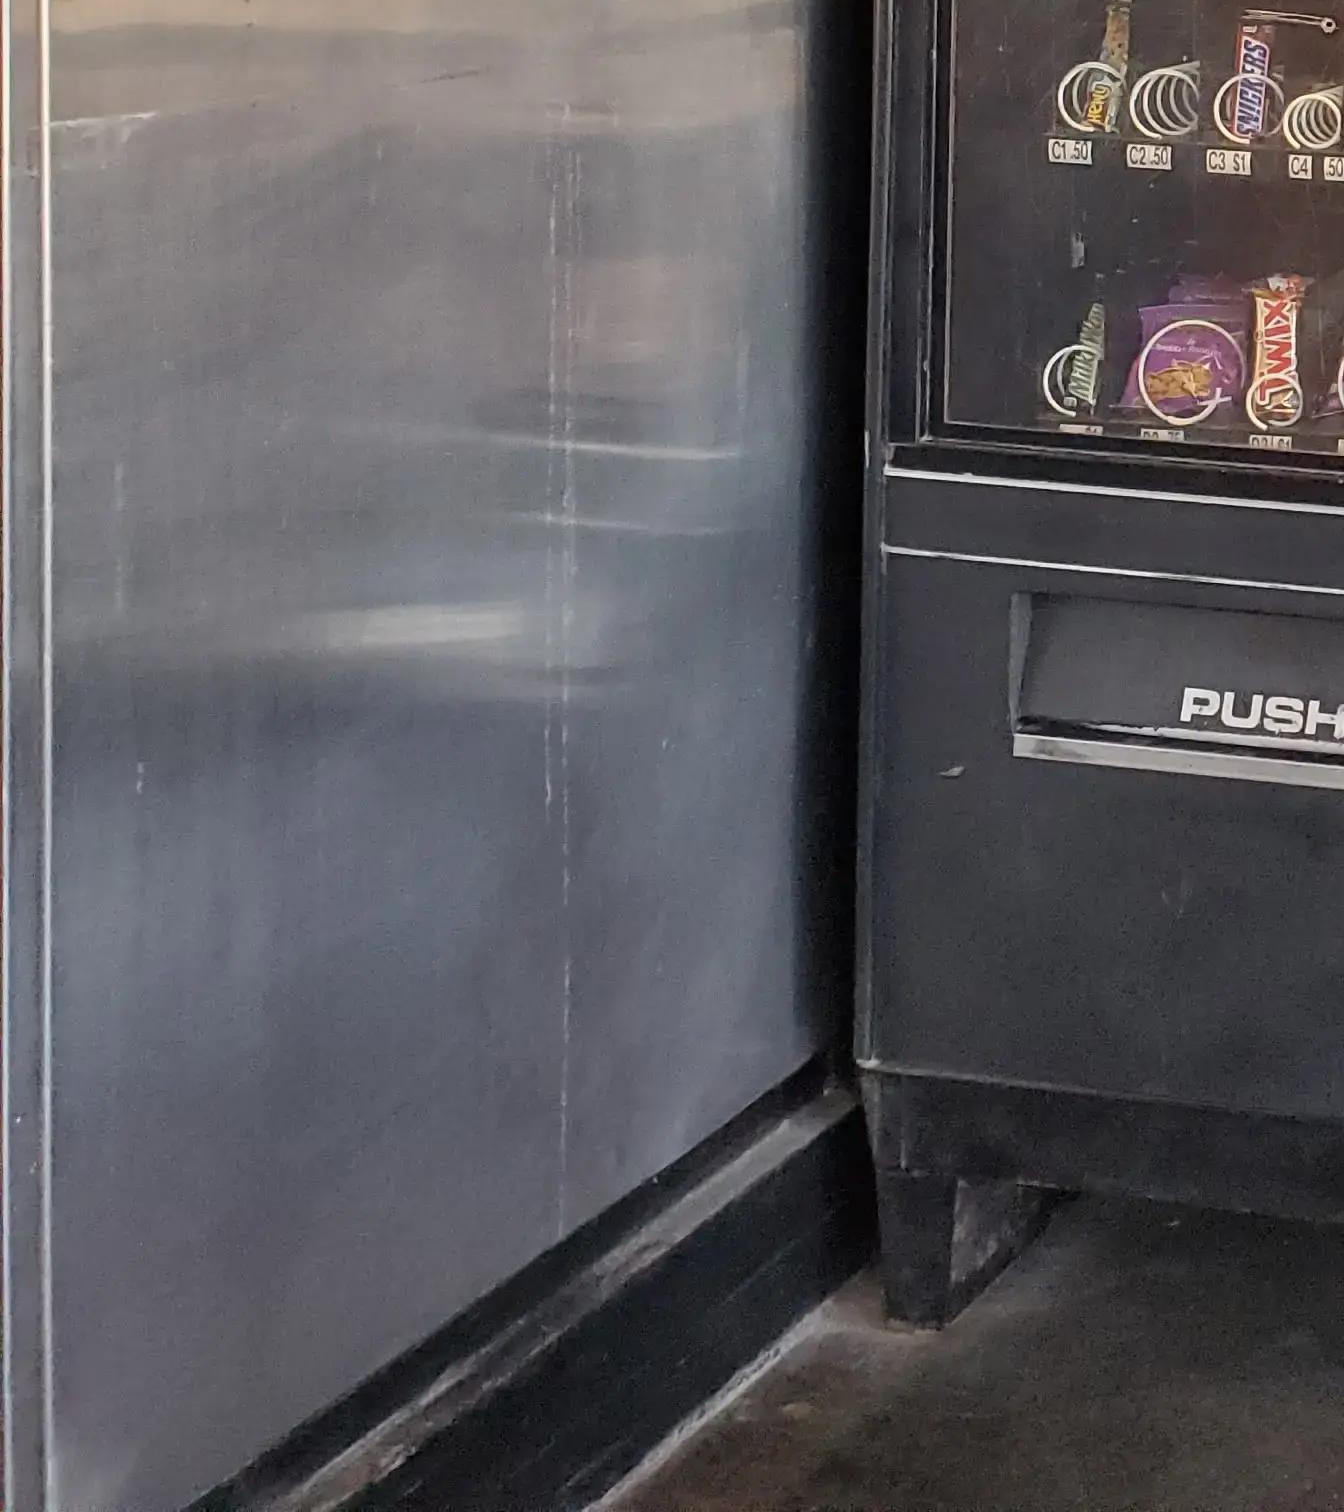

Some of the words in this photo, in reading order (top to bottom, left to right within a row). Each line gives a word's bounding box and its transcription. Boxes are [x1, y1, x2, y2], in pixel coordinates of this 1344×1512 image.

[1237, 38, 1269, 136] SNICKERS
[1051, 141, 1068, 160] C1
[1069, 141, 1089, 161] .50
[1129, 147, 1147, 165] C2
[1149, 147, 1169, 166] .50
[1208, 152, 1226, 170] C3
[1291, 157, 1308, 176] C4
[1326, 158, 1344, 177] .50
[1257, 300, 1293, 404] TWIX
